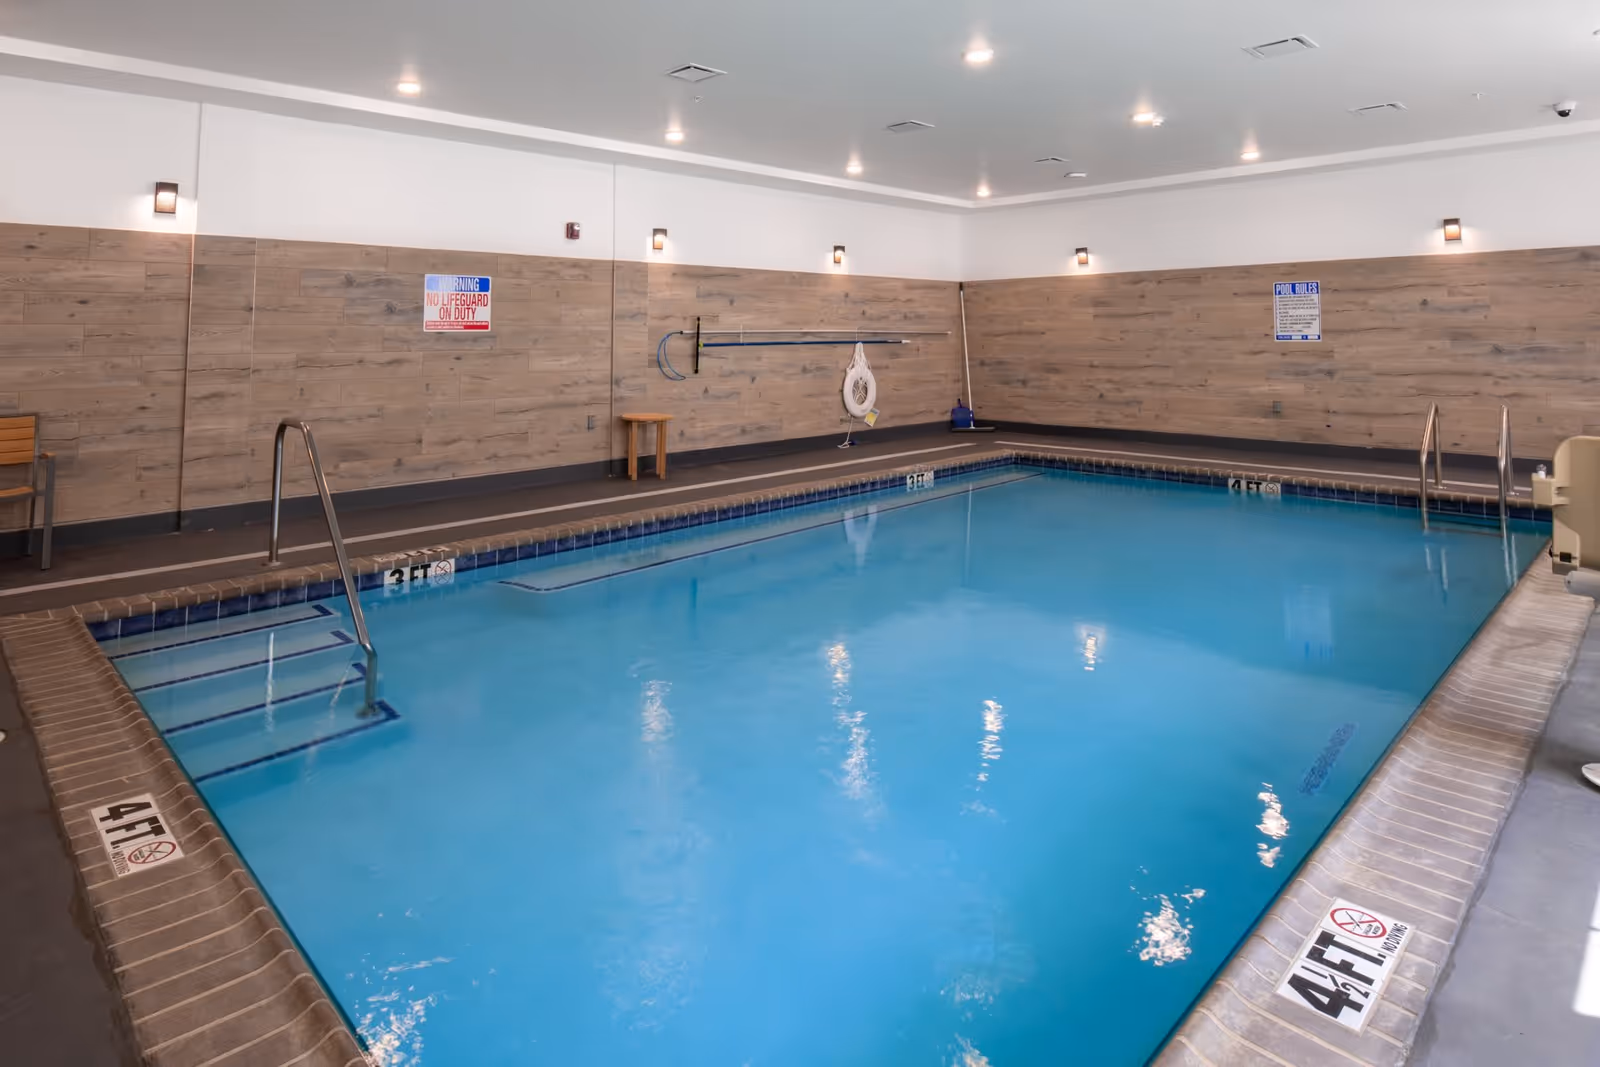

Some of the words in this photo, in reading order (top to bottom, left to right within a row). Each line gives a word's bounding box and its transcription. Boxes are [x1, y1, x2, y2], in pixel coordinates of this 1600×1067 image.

[1276, 284, 1295, 295] POOL
[1296, 282, 1317, 294] RULES
[426, 292, 439, 307] NO
[441, 292, 489, 307] LIFEGUARD
[439, 307, 451, 321] ON
[454, 307, 477, 321] DUTY
[389, 568, 404, 585] 3
[409, 563, 431, 582] FT
[99, 801, 153, 822] 4
